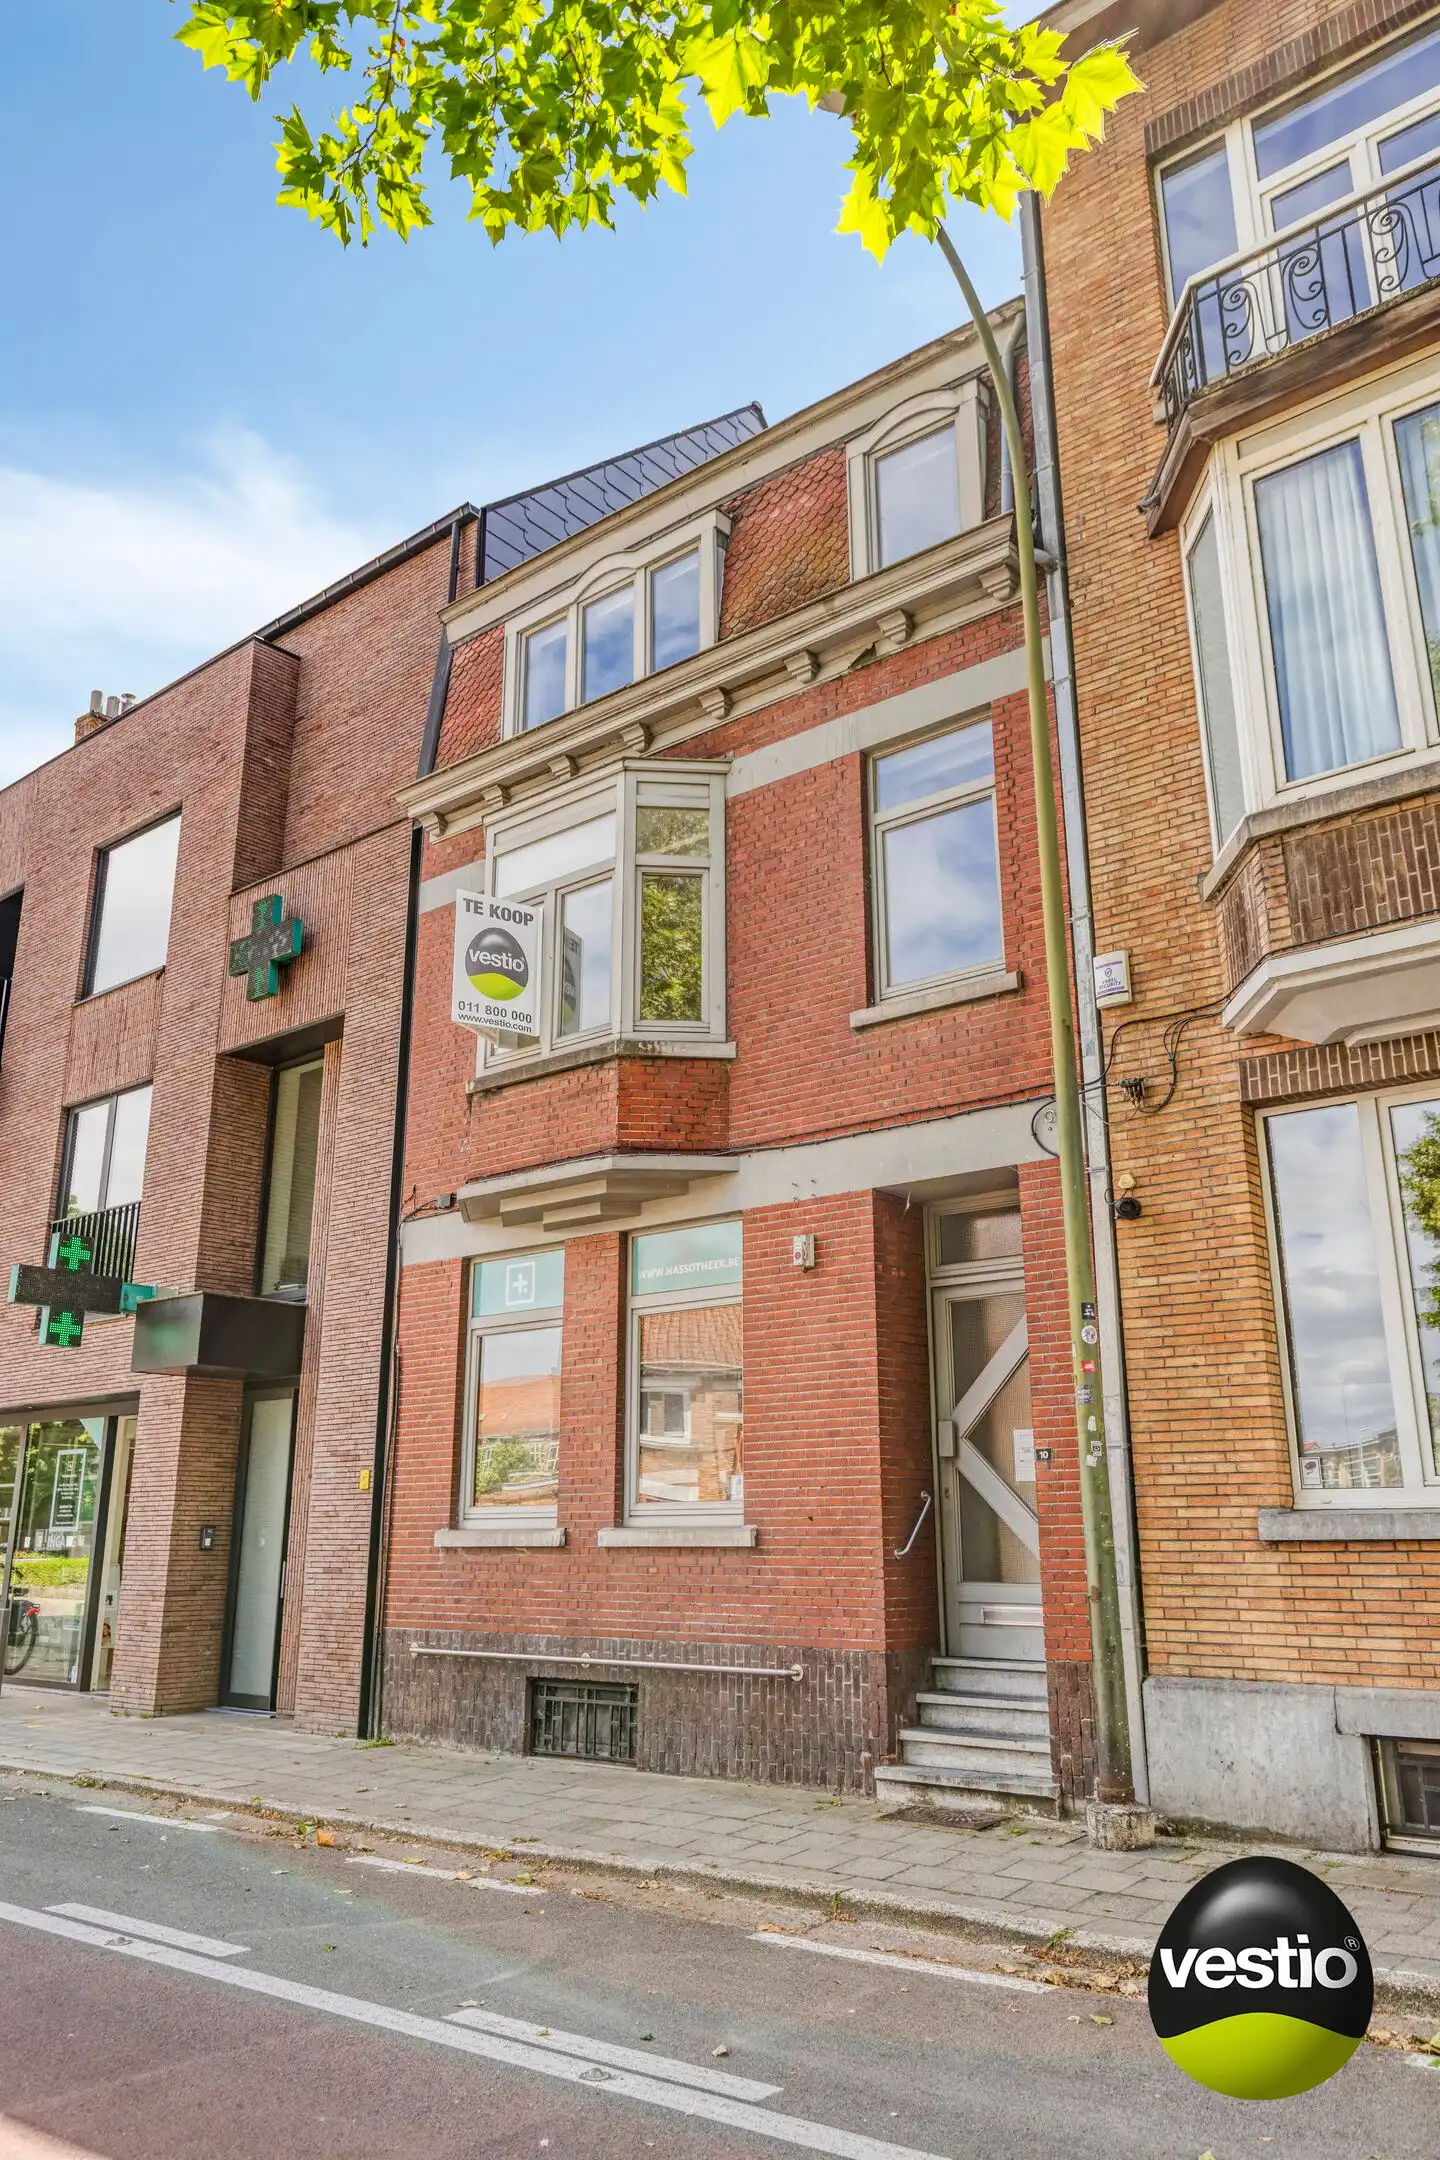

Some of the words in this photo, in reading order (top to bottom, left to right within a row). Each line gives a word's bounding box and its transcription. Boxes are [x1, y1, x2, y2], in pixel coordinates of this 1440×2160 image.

[463, 898, 483, 915] TE
[489, 904, 534, 926] KOOP
[1099, 981, 1121, 989] SECURITY
[458, 1001, 480, 1013] 011
[485, 1005, 507, 1018] 800
[511, 1010, 532, 1024] 000
[457, 1013, 532, 1033] www.vestio.com
[1039, 1450, 1049, 1459] 10
